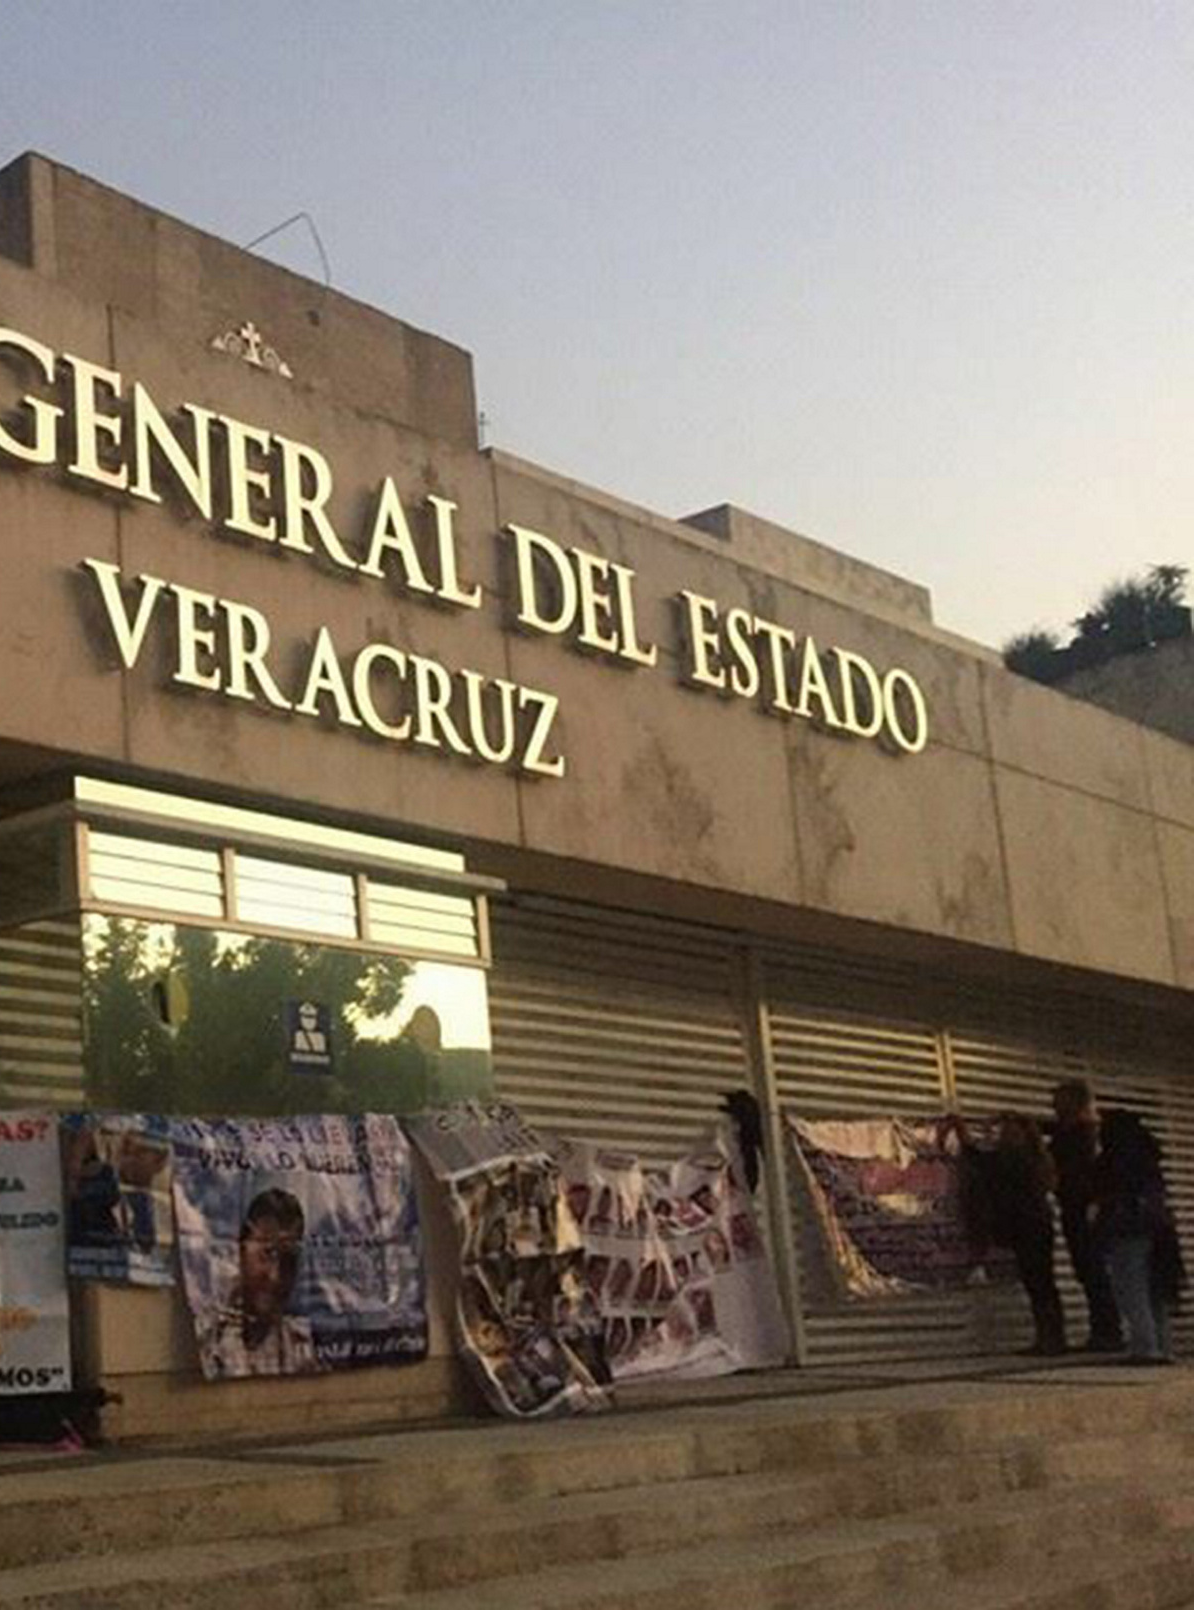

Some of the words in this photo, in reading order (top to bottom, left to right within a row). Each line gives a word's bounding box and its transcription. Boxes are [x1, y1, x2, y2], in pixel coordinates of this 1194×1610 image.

[82, 556, 566, 777] VERACRUZ
[507, 522, 658, 668] DEL
[679, 588, 928, 755] ESTADO
